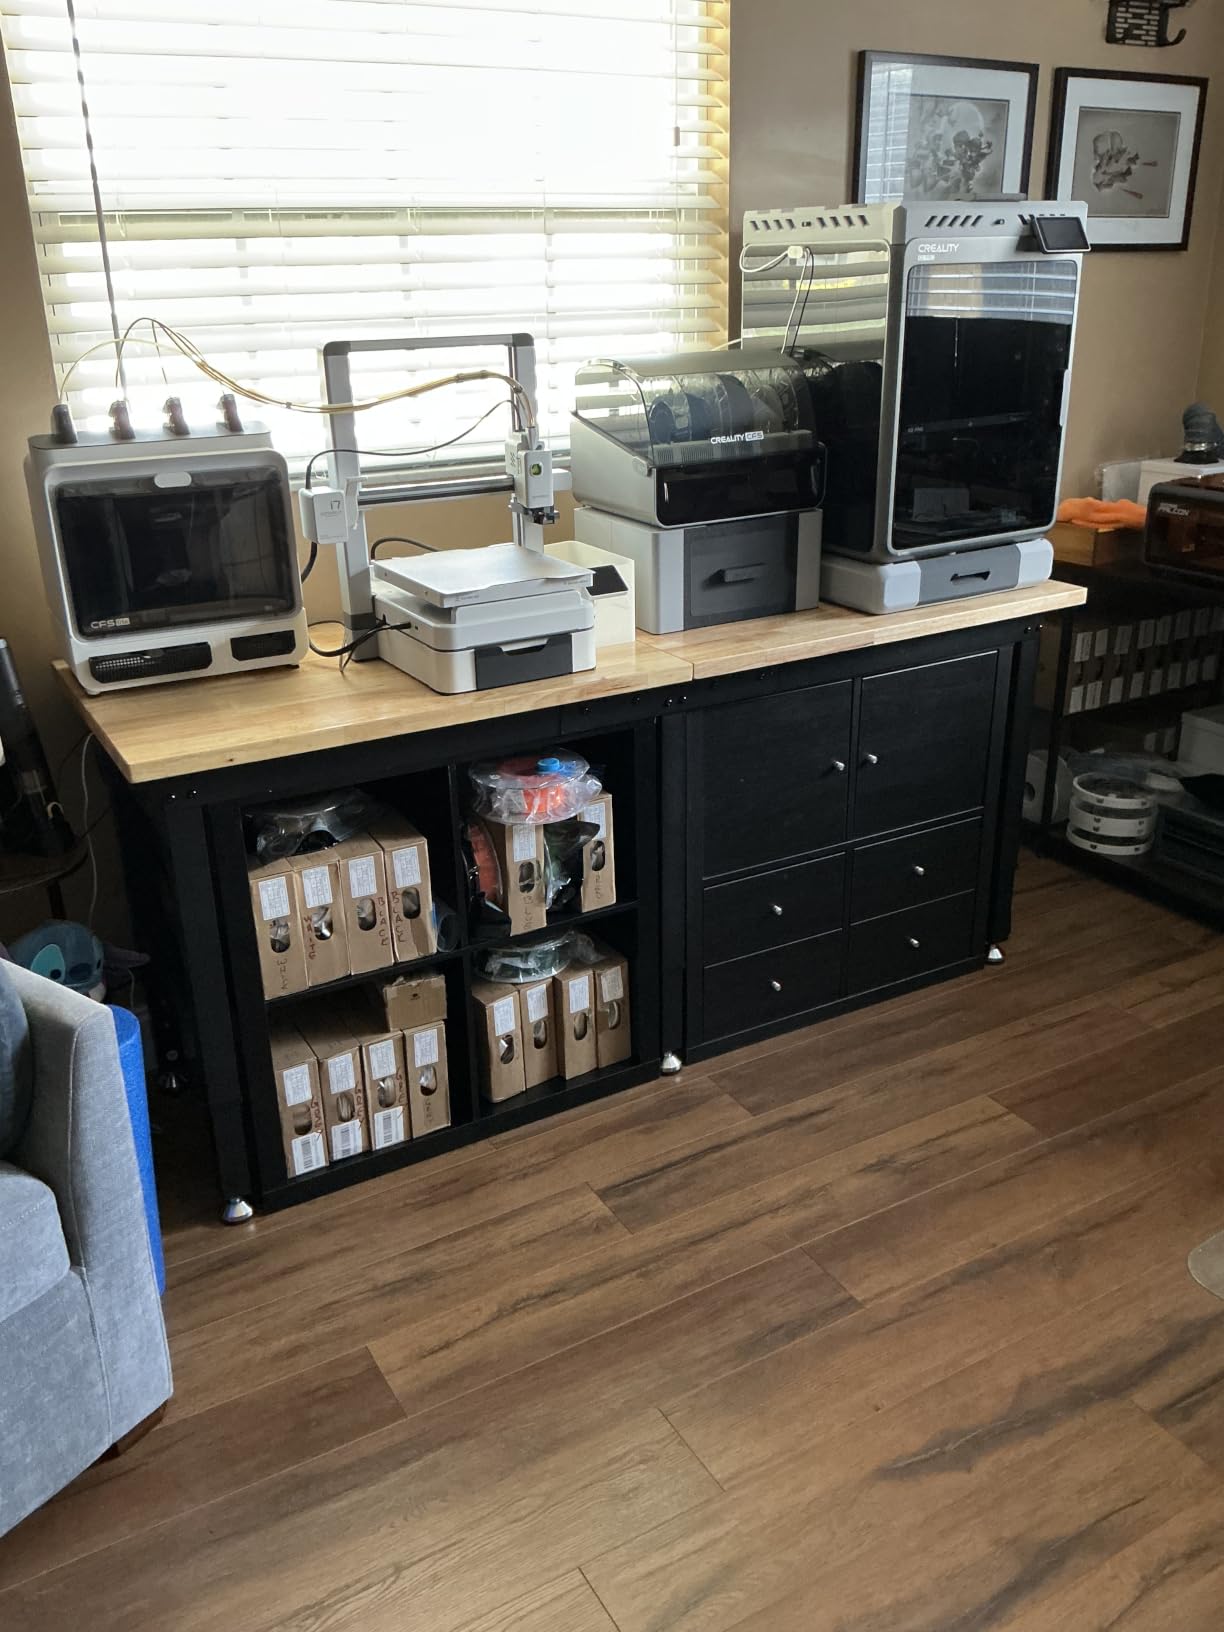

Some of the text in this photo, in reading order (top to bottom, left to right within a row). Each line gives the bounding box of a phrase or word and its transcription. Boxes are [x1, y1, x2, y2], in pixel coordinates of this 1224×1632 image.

[918, 243, 960, 253] CREALITY
[710, 433, 745, 445] CREALITY
[90, 619, 115, 629] CFS
